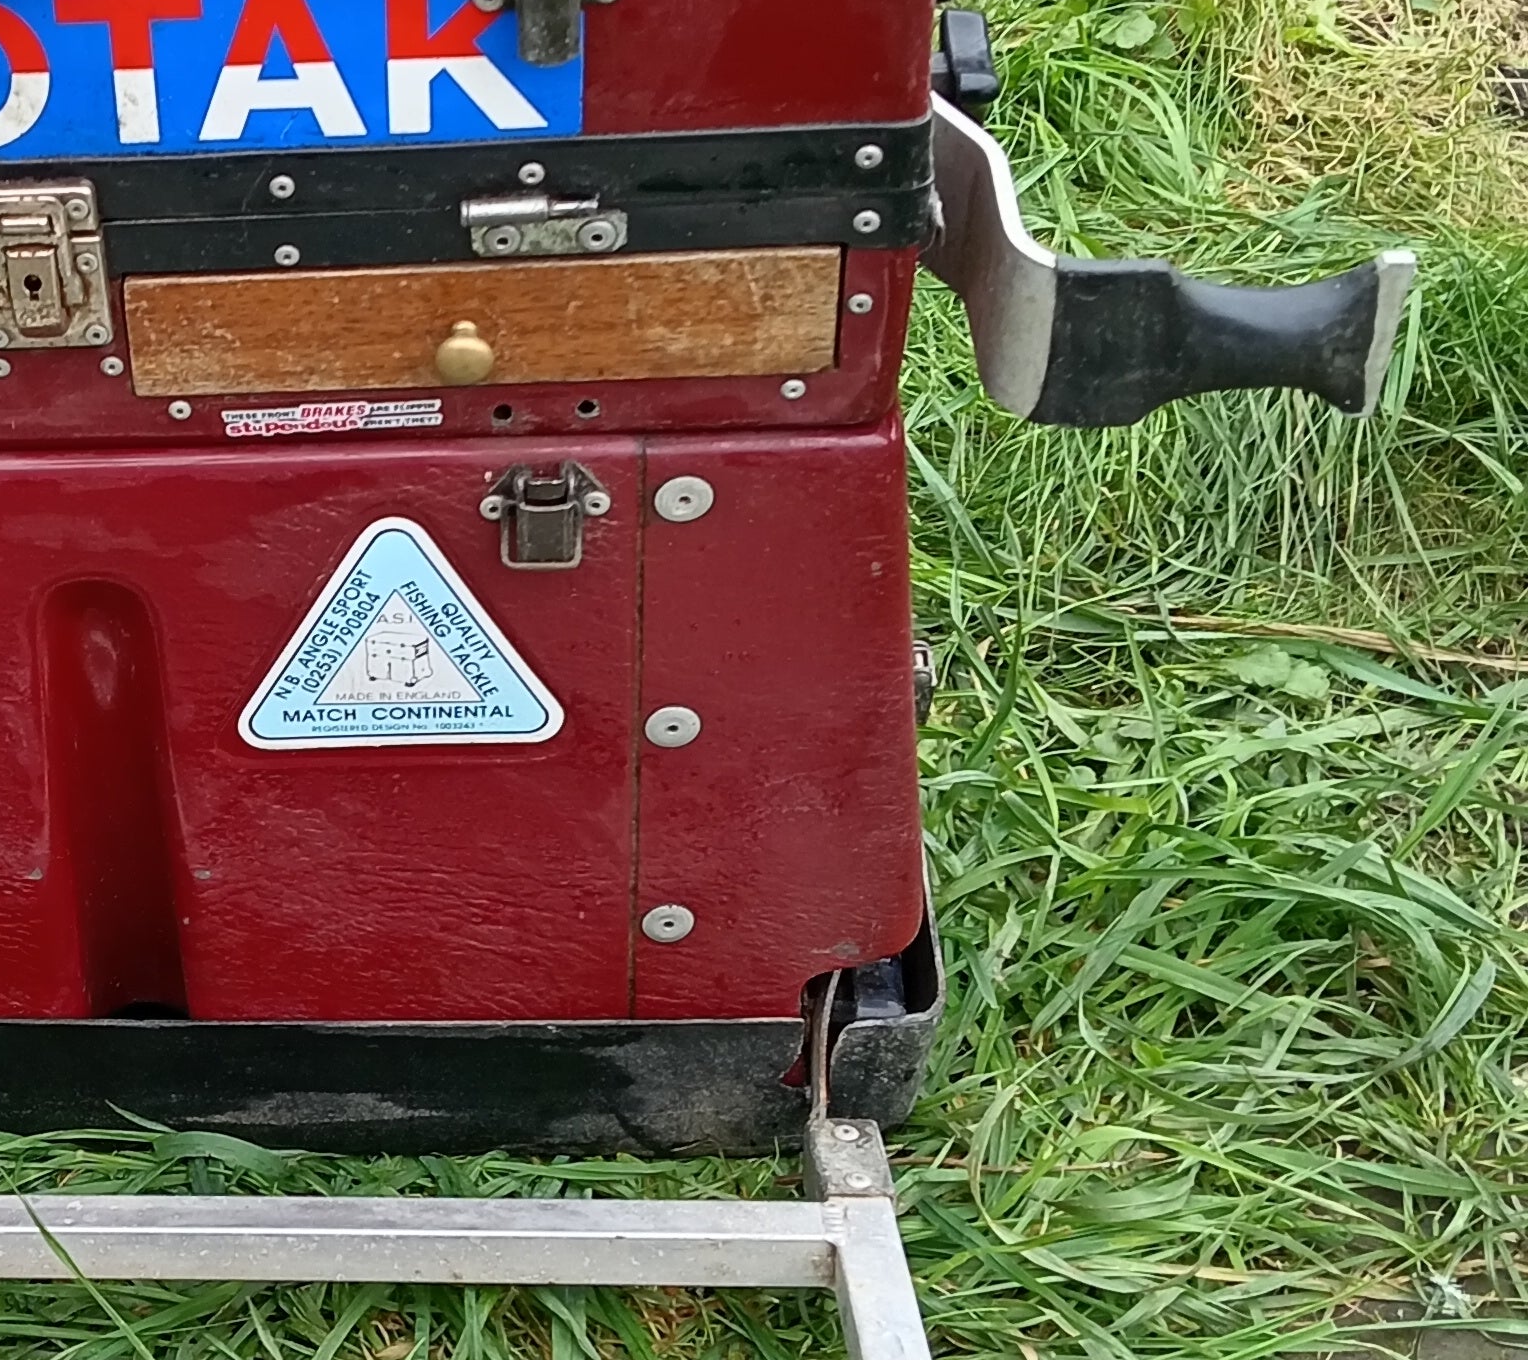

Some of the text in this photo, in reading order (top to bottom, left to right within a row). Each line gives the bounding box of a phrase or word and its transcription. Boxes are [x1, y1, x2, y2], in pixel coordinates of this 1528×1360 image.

[300, 404, 366, 419] BRAKES
[228, 416, 360, 435] stupendous
[297, 618, 340, 669] ANGLE
[331, 569, 373, 617] SPORT
[400, 580, 499, 698] FISHING TACKLE
[441, 602, 496, 661] QUALITY
[301, 591, 381, 694] (0253) 790804
[335, 690, 461, 702] MADE IN ENGLAND
[283, 704, 514, 723] MATCH CONTINENTAL
[371, 723, 410, 731] DESIGN
